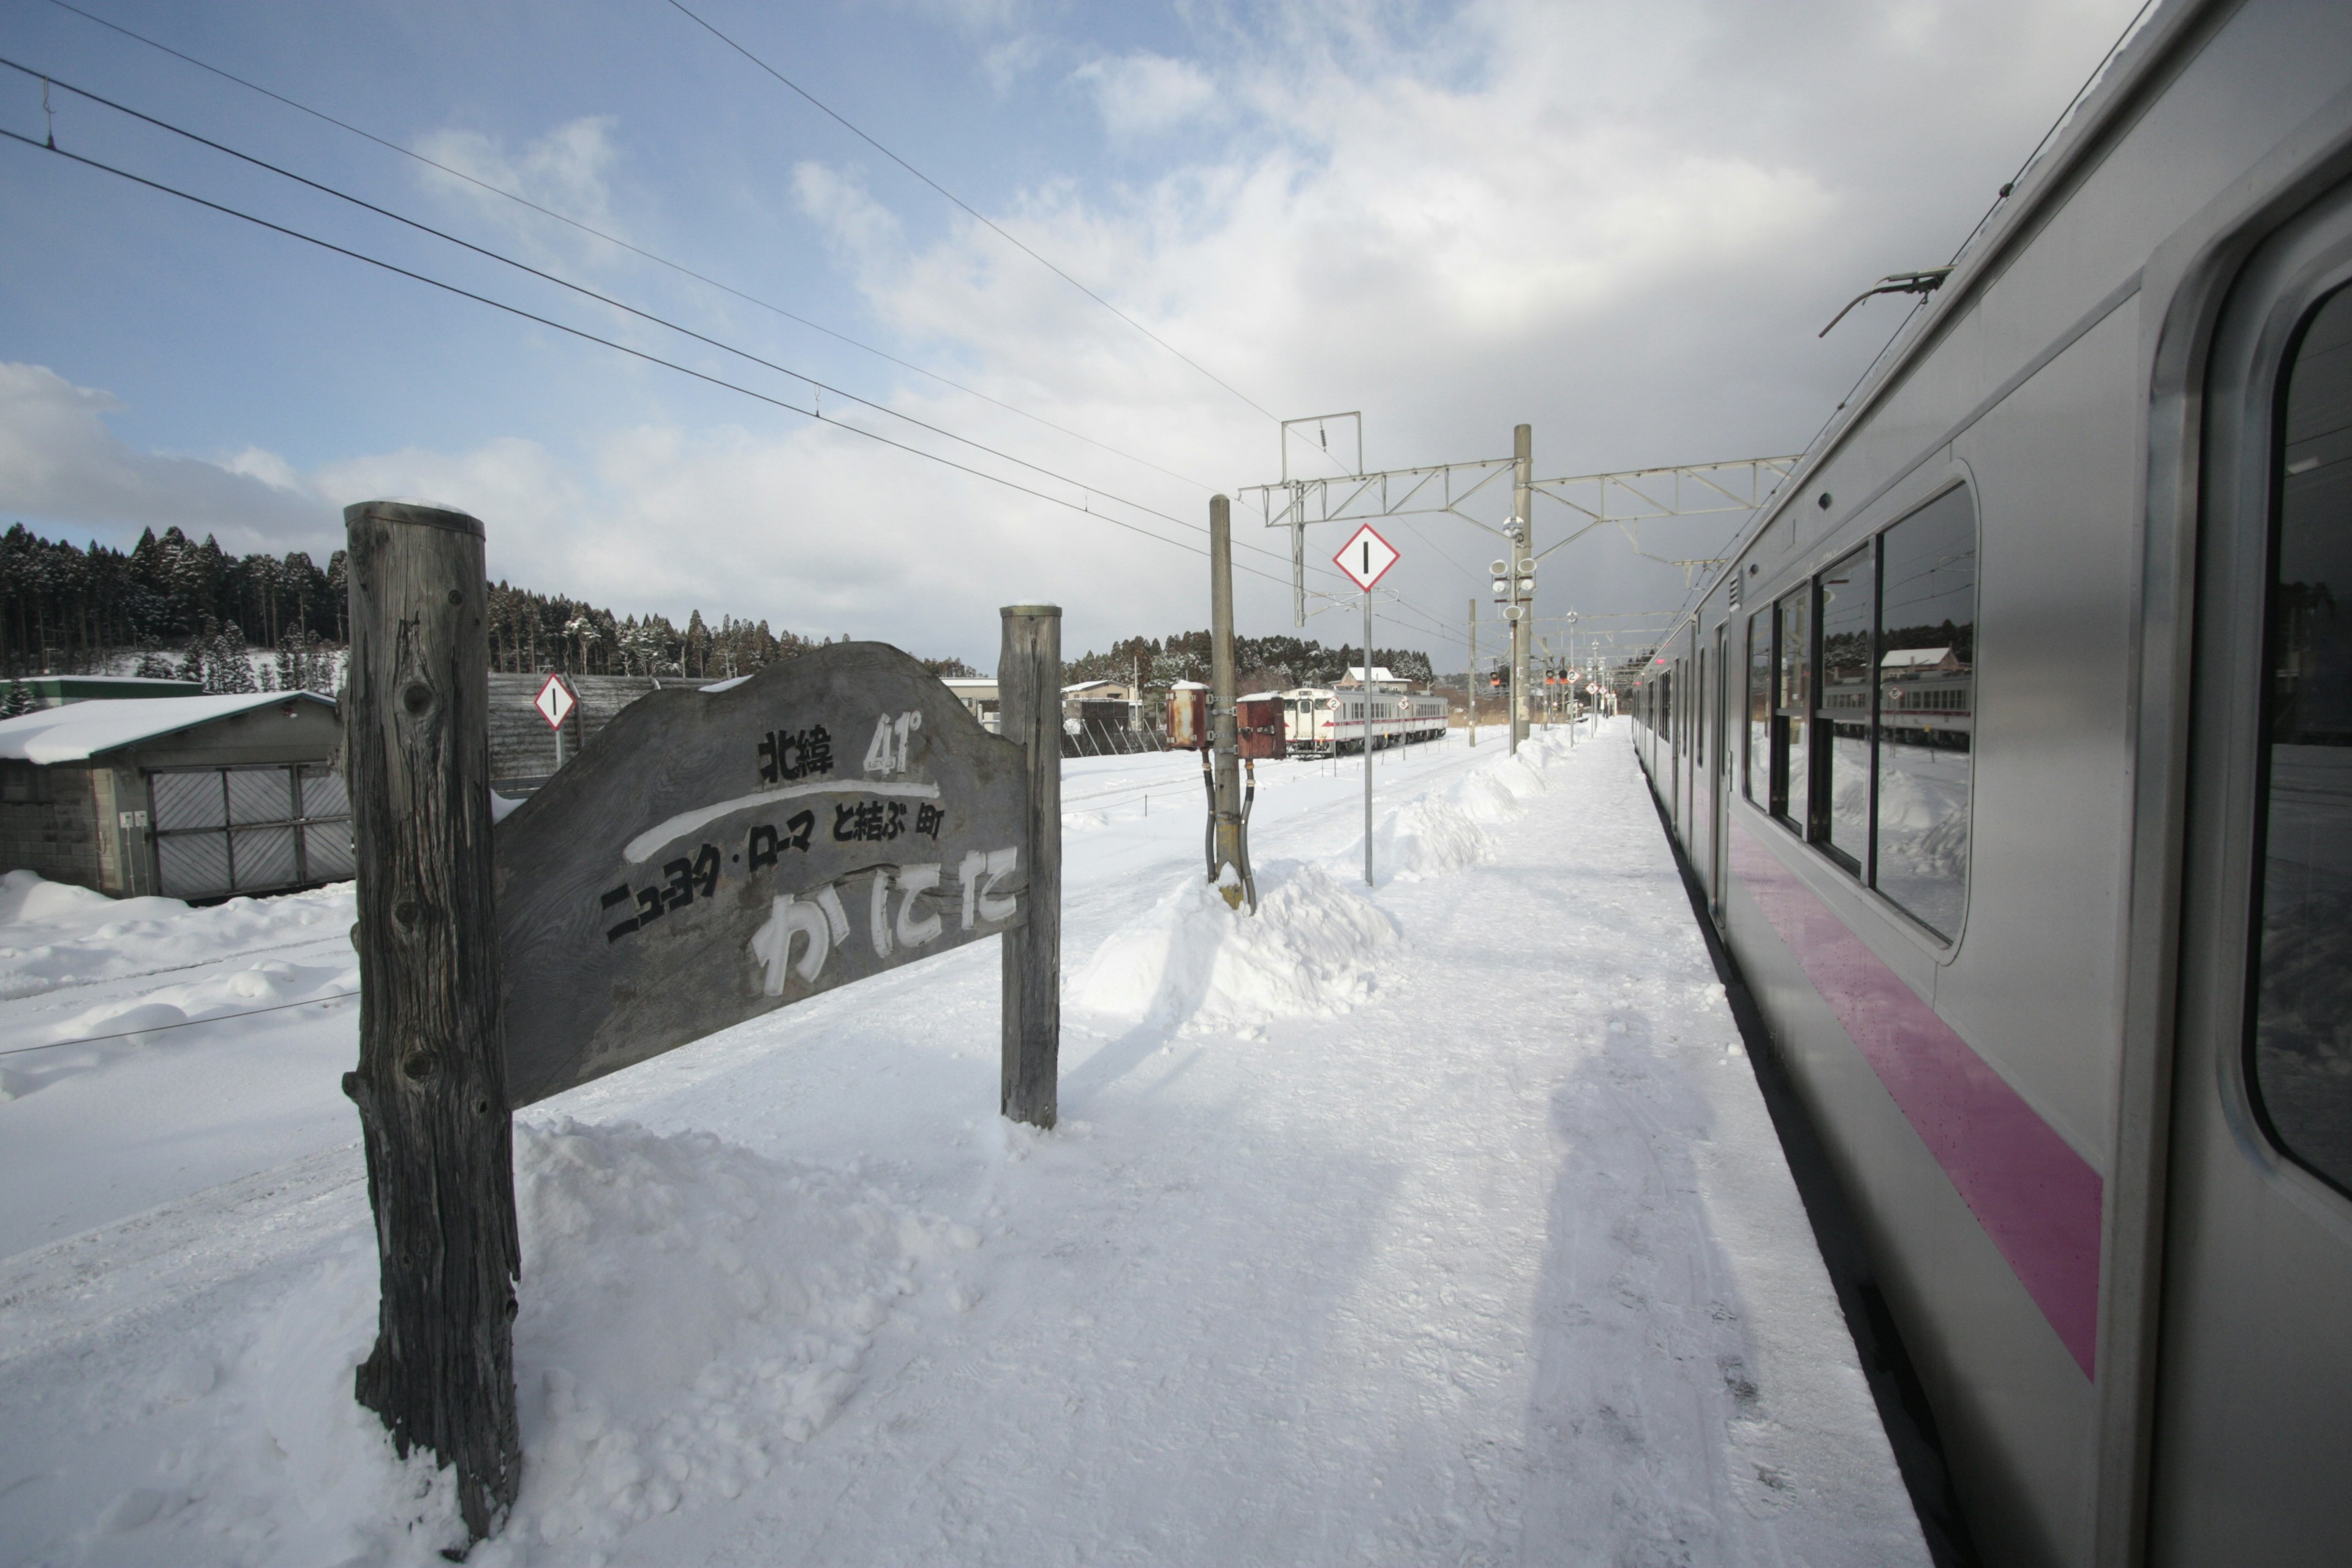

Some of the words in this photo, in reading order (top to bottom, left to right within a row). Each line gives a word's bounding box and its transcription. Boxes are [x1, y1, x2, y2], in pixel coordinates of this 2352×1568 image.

[1363, 541, 1368, 574] 1
[1569, 671, 1575, 680] 2
[1331, 699, 1336, 708] 2
[758, 724, 833, 783] 北緯
[751, 846, 1017, 996] かにた
